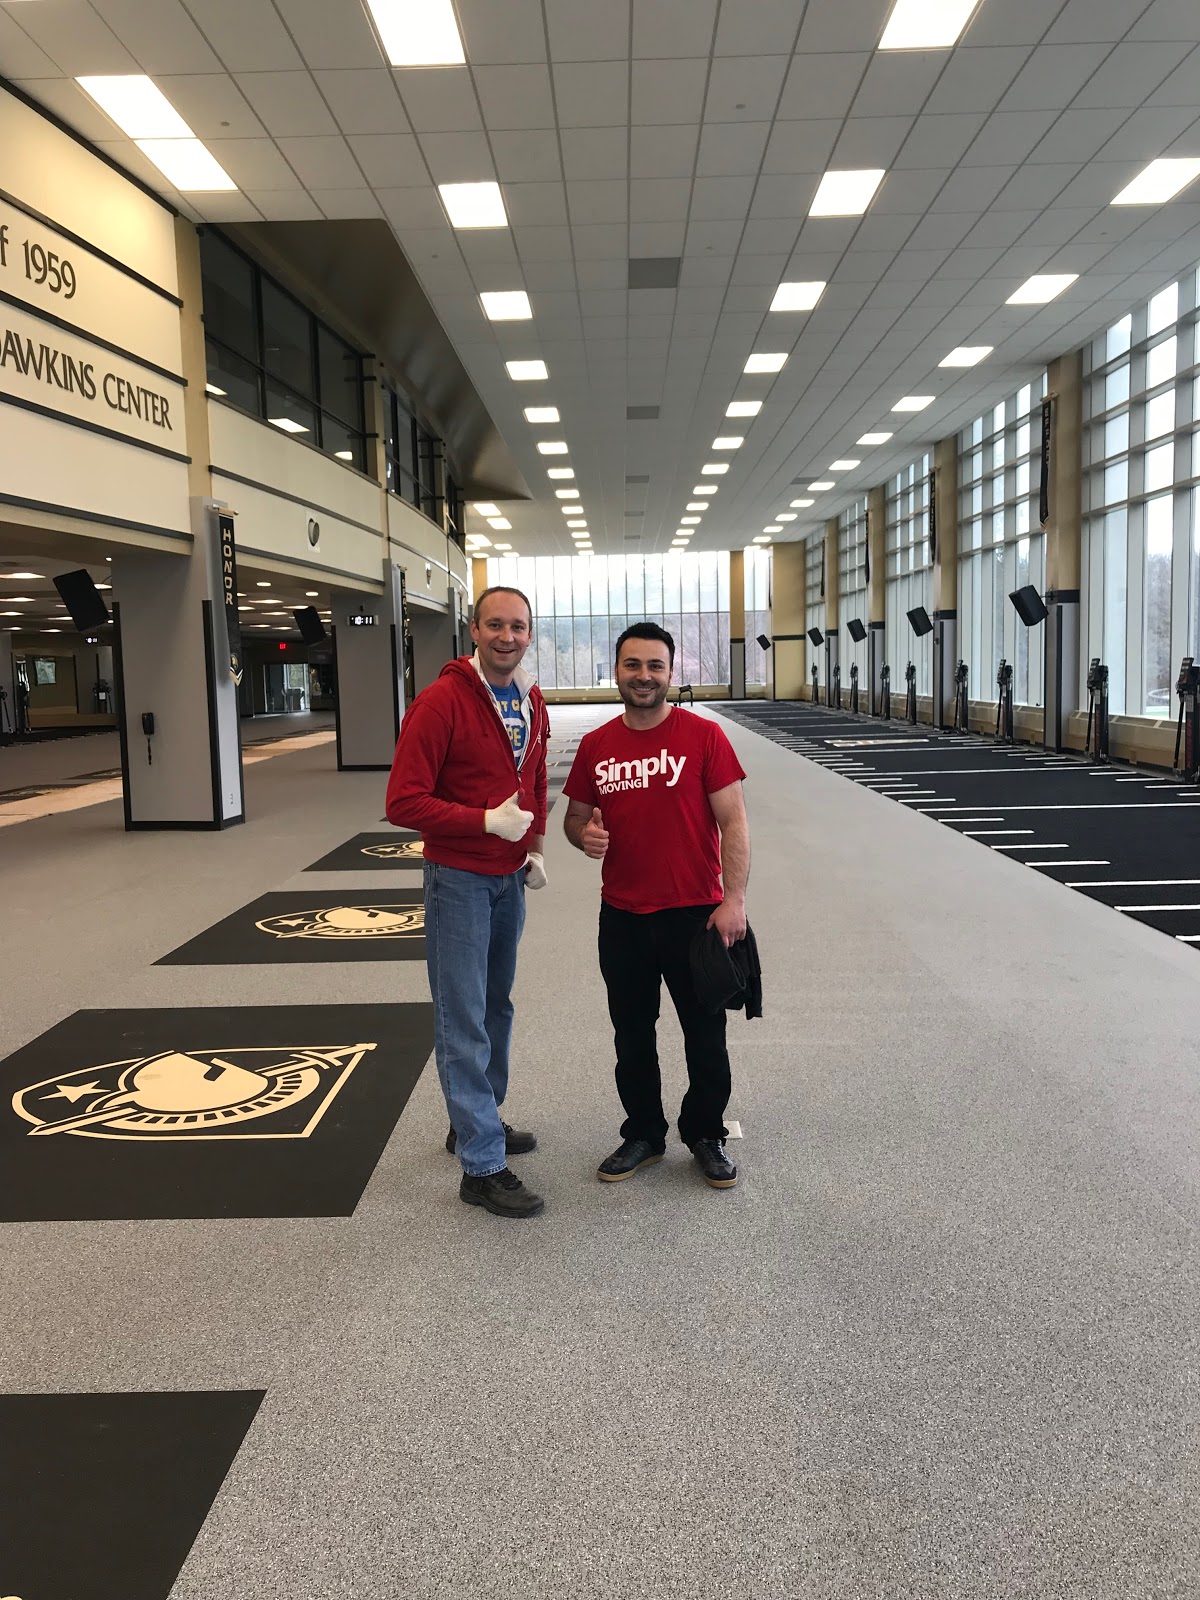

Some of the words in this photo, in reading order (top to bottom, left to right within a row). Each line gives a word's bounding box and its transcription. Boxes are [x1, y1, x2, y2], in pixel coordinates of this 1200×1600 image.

[22, 239, 77, 299] 1959
[0, 329, 97, 400] AWKINS
[103, 372, 173, 431] CENTER
[223, 528, 234, 605] HONOR
[594, 748, 687, 788] Simply
[598, 778, 643, 796] MOVING
